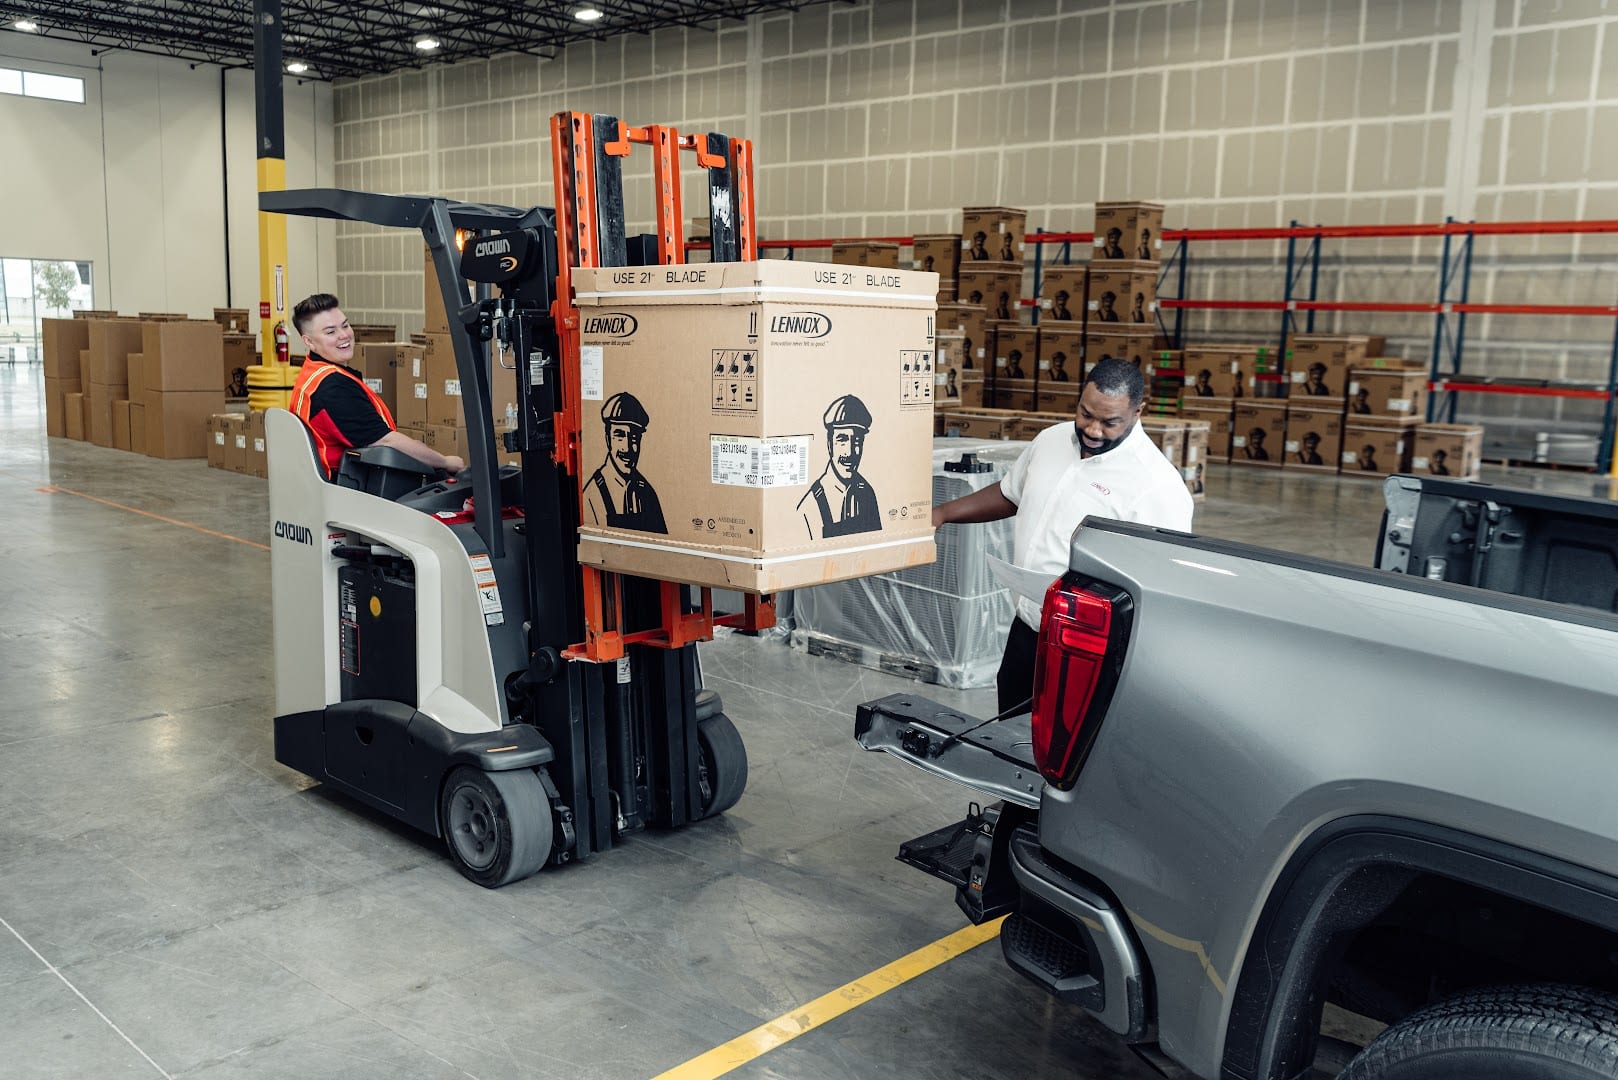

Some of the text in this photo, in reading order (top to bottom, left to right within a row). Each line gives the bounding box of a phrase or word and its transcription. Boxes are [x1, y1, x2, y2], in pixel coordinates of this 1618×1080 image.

[475, 239, 511, 257] CROWN
[613, 272, 635, 284] USE
[666, 271, 707, 283] BLADE
[814, 271, 837, 284] USE
[866, 274, 901, 288] BLADE
[583, 317, 628, 334] LENNOX
[770, 316, 821, 334] LENNOX
[274, 520, 313, 546] CROWN
